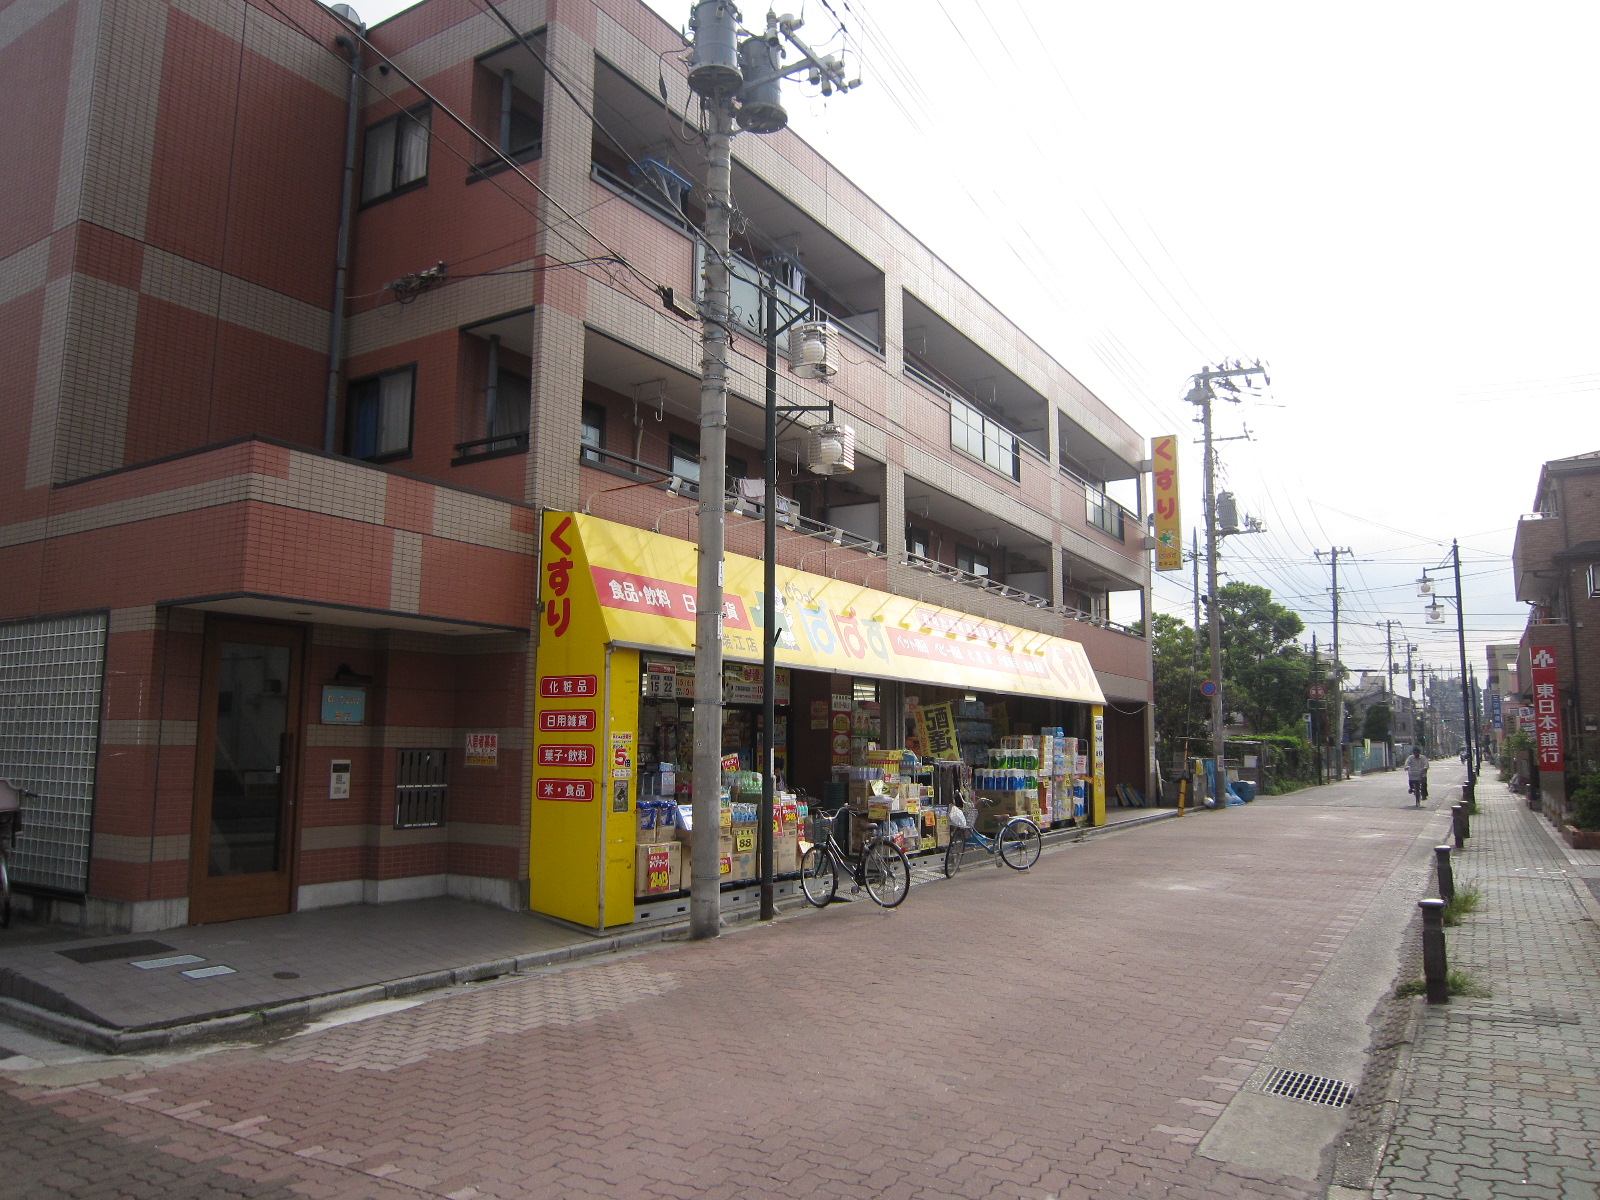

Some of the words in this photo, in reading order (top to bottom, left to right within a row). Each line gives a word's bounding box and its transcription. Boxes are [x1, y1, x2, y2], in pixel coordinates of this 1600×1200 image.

[1155, 438, 1176, 521] くすり
[546, 516, 574, 638] くすり
[608, 579, 672, 610] 食品・飲料
[682, 594, 740, 621] 日貨
[796, 600, 890, 665] ぱぱす
[1046, 644, 1096, 693] くすり
[549, 681, 587, 694] 化粧品
[650, 681, 659, 692] 15
[663, 682, 673, 693] 22
[546, 715, 588, 727] 日用雑貨
[1536, 683, 1560, 763] 東日本銀行
[466, 735, 497, 748] 入居者募集
[544, 749, 588, 762] 菓子・飲料
[543, 784, 586, 797] 米・食品
[650, 870, 668, 888] 248
